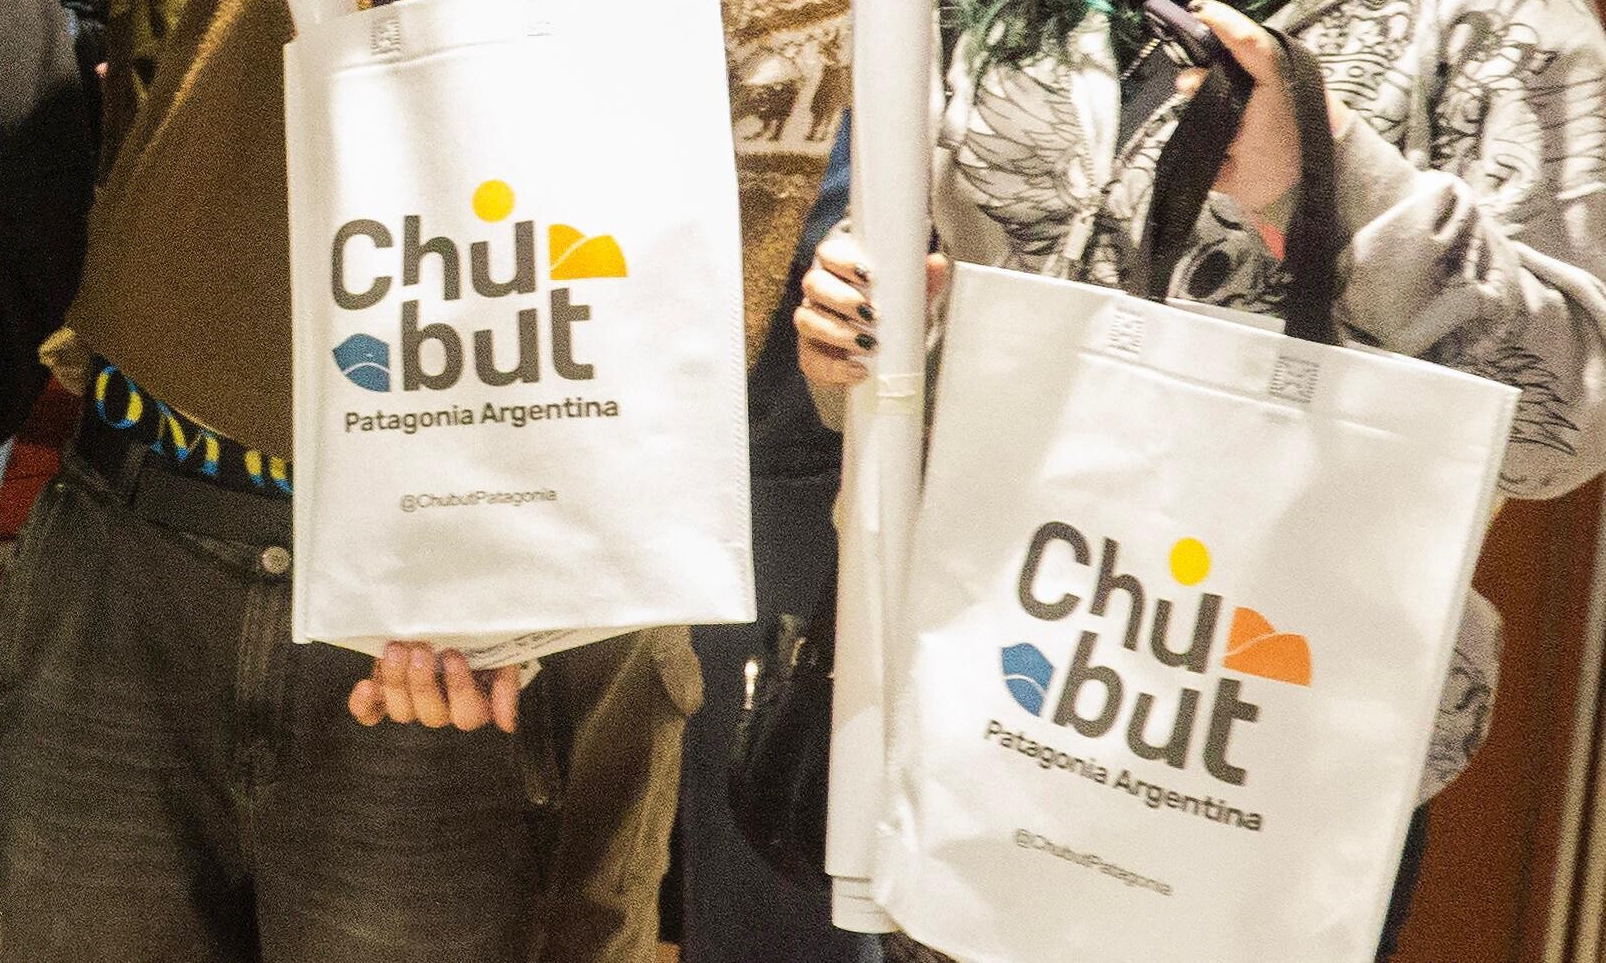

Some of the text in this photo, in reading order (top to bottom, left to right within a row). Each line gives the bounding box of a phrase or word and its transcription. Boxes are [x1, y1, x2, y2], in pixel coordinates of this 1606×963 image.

[401, 288, 595, 392] but
[344, 396, 620, 435] Patagonia Argentina
[1053, 631, 1260, 787] but
[983, 718, 1263, 832] Patagonia Argentina
